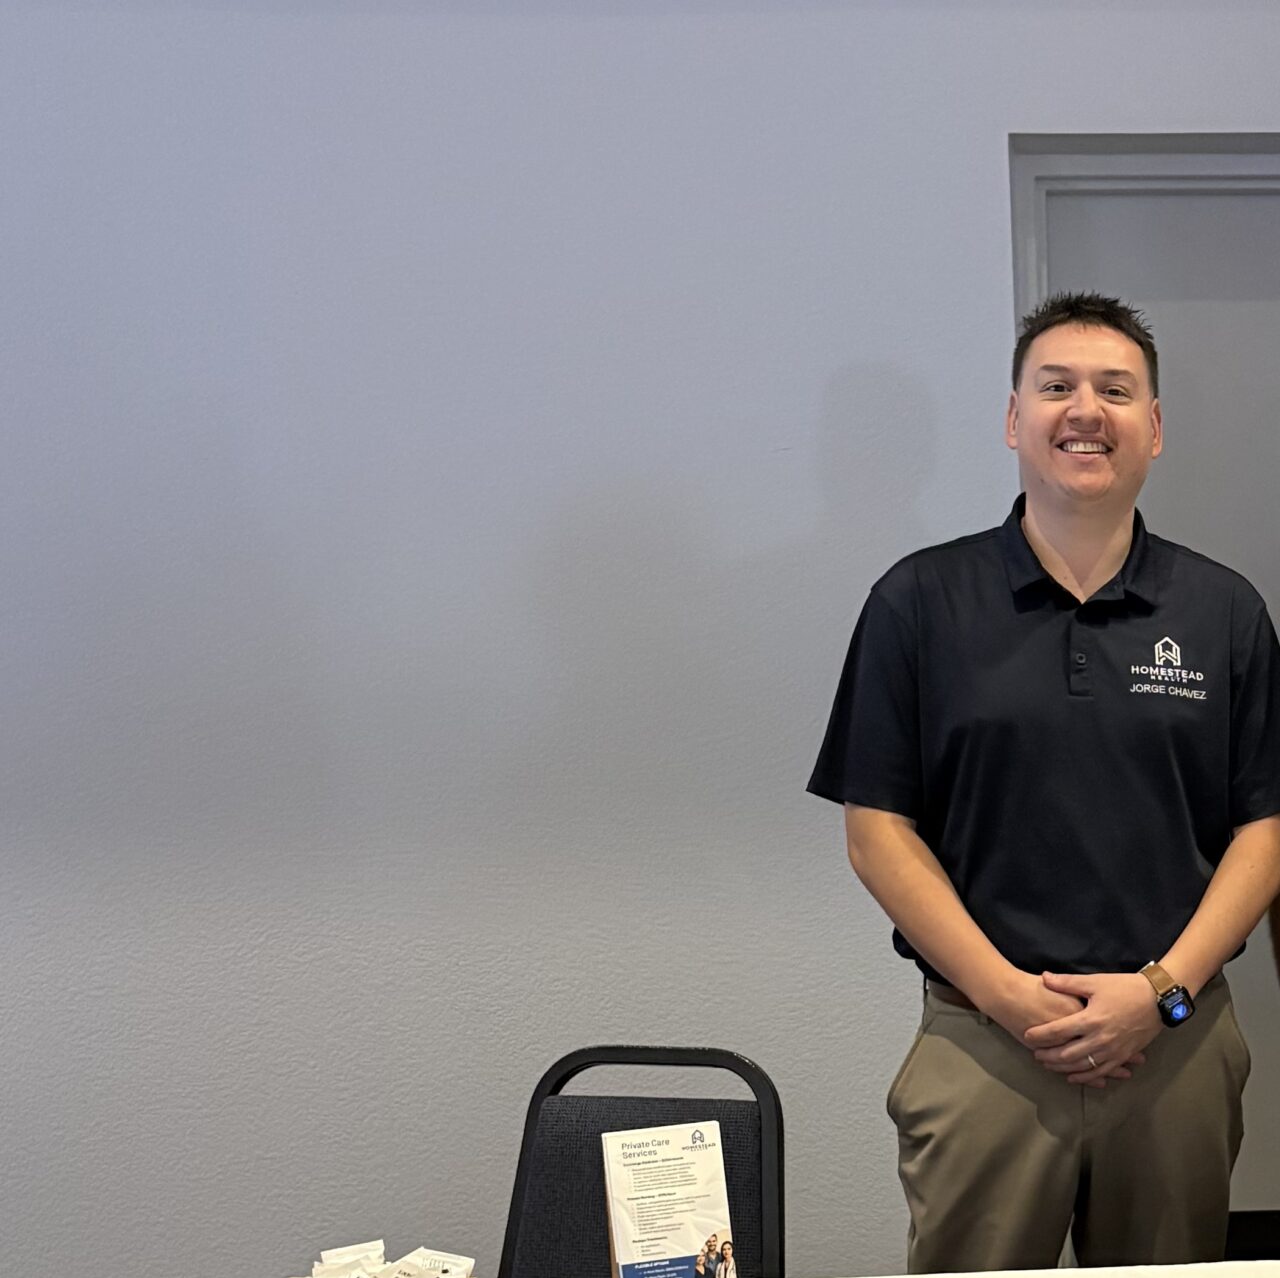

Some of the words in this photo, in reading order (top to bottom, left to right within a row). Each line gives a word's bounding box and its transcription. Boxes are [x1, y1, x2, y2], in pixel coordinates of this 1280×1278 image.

[1130, 665, 1204, 681] HOMESTEAD
[1129, 683, 1166, 694] JORGE
[1168, 686, 1207, 700] CHAVEZ
[621, 1141, 650, 1150] Private
[651, 1139, 670, 1147] Care
[622, 1149, 657, 1159] Services
